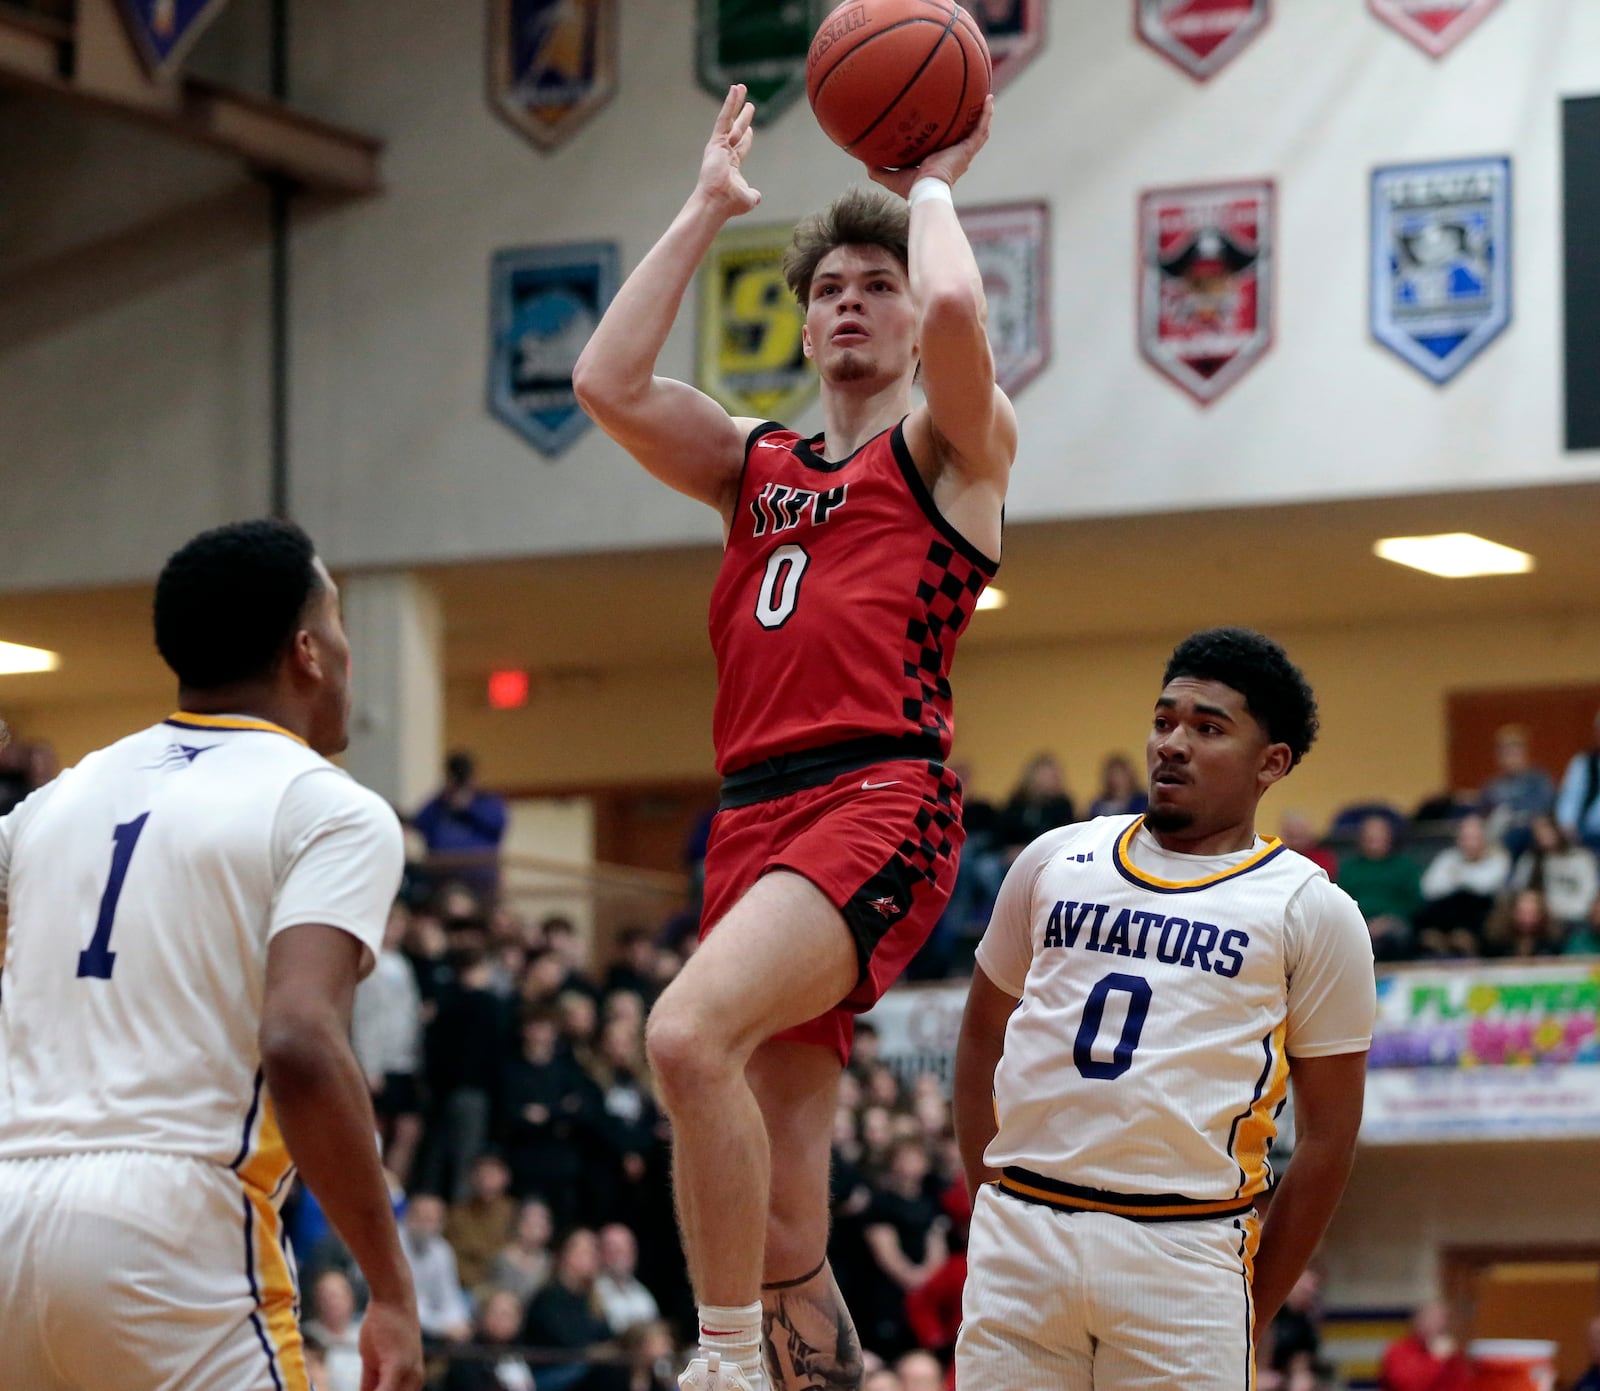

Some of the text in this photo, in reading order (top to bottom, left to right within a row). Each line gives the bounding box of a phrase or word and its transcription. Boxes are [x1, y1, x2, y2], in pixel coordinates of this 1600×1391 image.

[755, 543, 811, 631] 0
[76, 810, 151, 979] 1
[1043, 900, 1250, 978] AVIATORS
[1073, 972, 1153, 1080] 0
